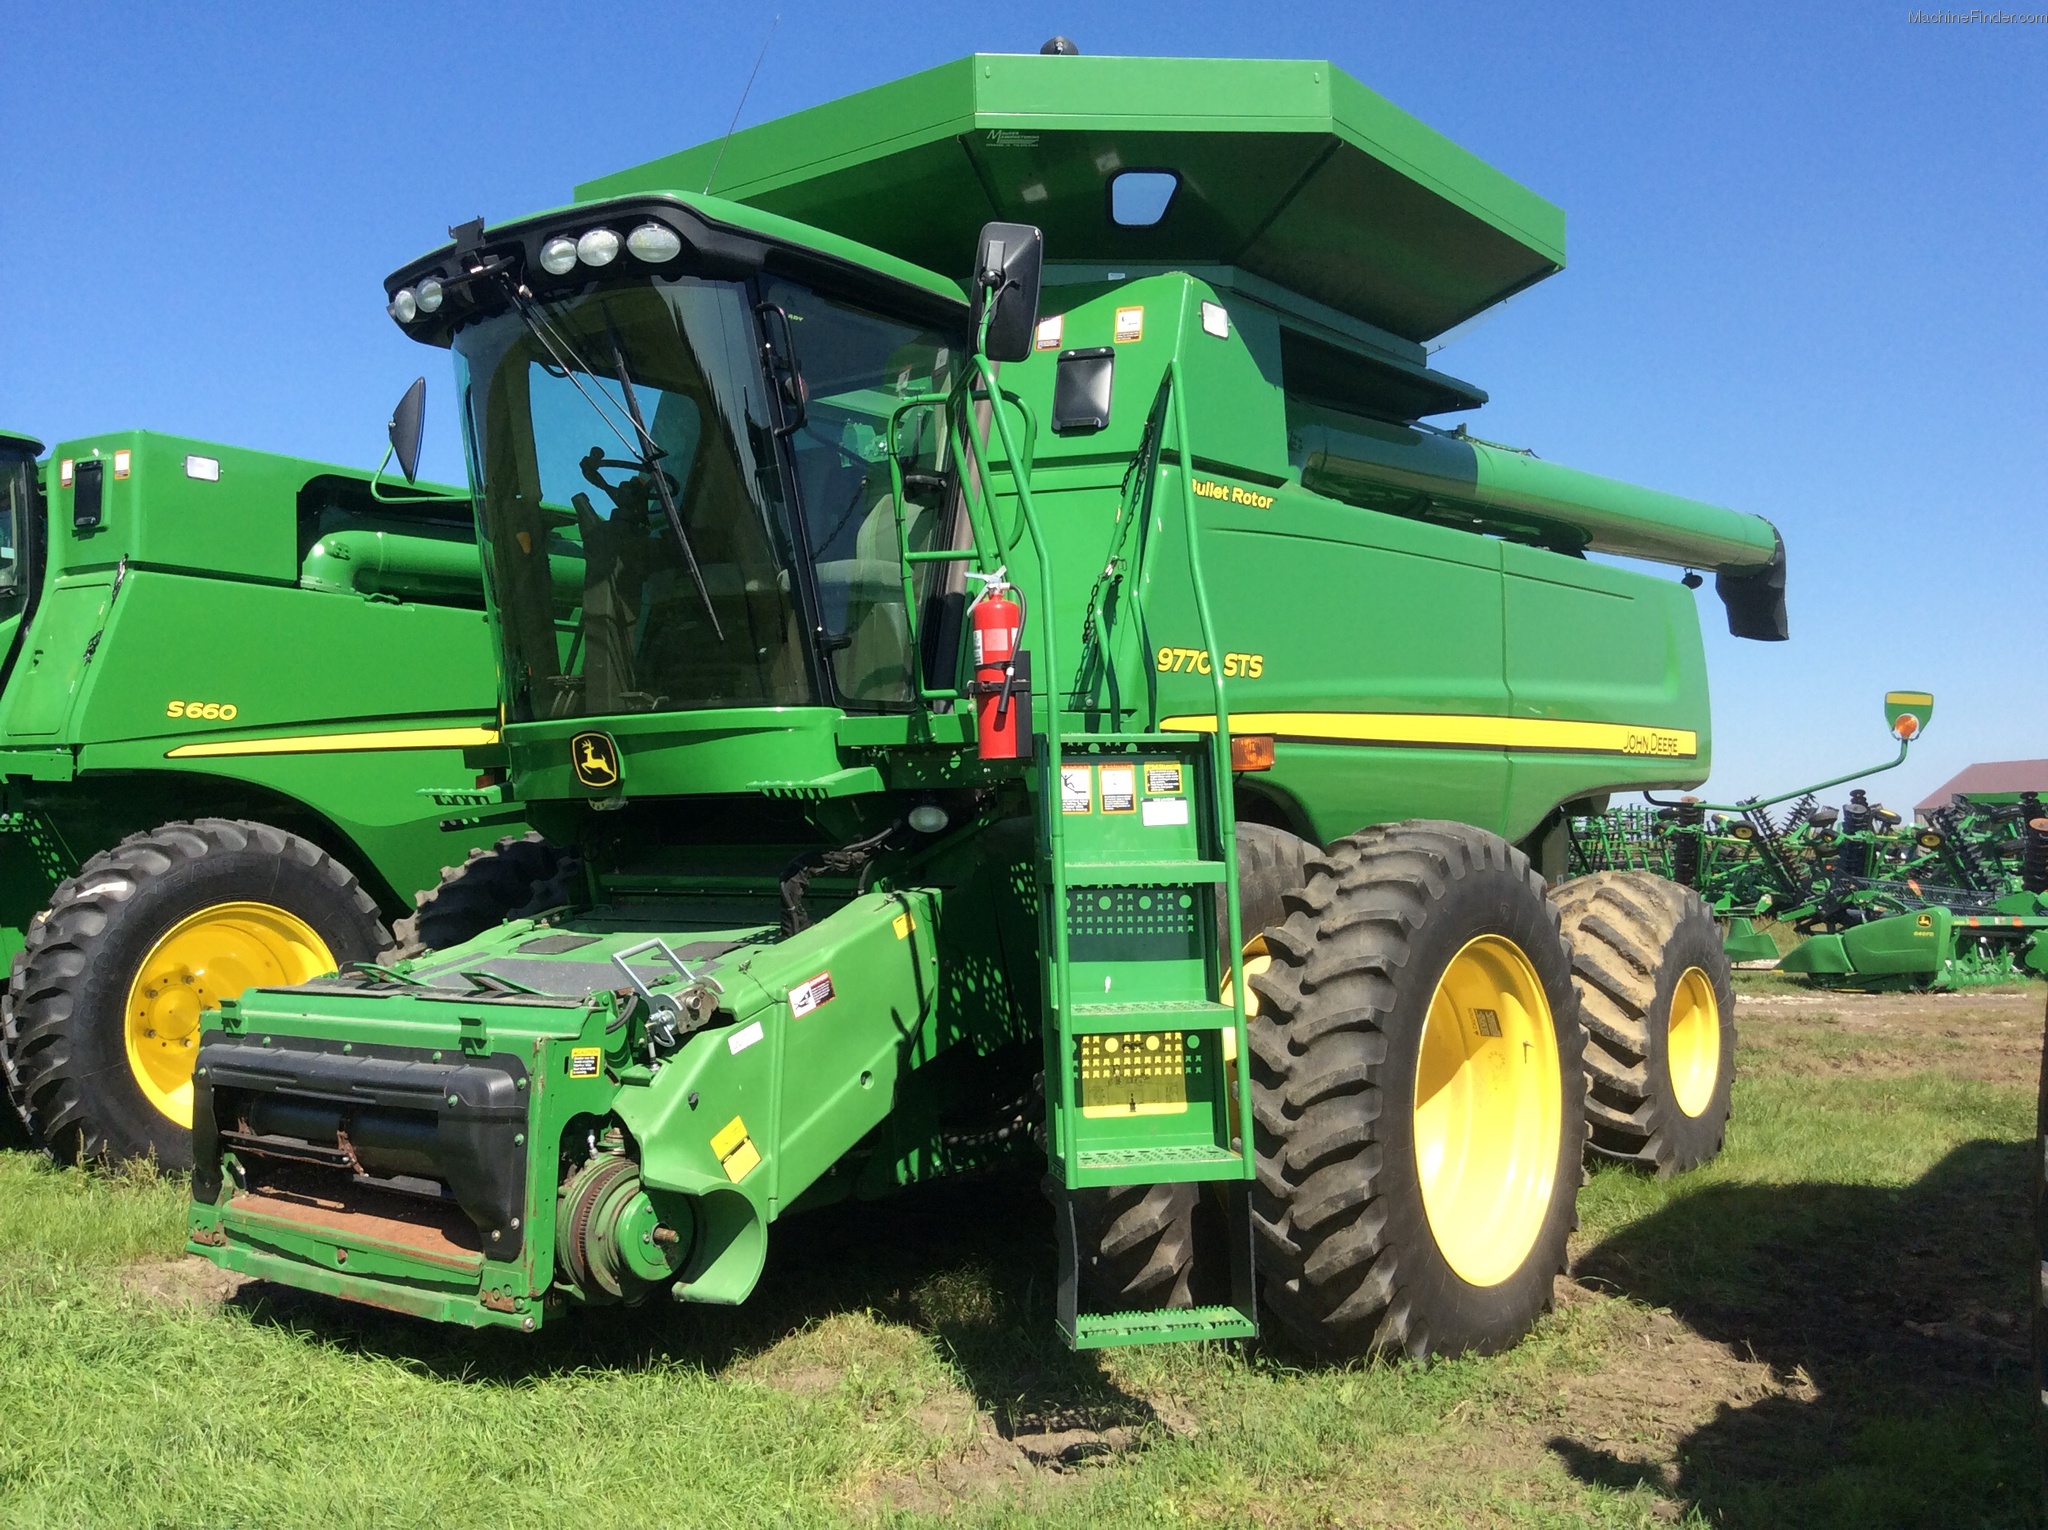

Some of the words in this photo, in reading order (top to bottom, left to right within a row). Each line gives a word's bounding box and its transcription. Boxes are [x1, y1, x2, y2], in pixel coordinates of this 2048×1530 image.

[1231, 486, 1274, 509] Rotor
[1157, 646, 1211, 675] 9770
[1223, 652, 1263, 679] STS
[166, 700, 238, 721] S660
[1623, 731, 1649, 751] JOHN
[1650, 732, 1679, 753] DEERE
